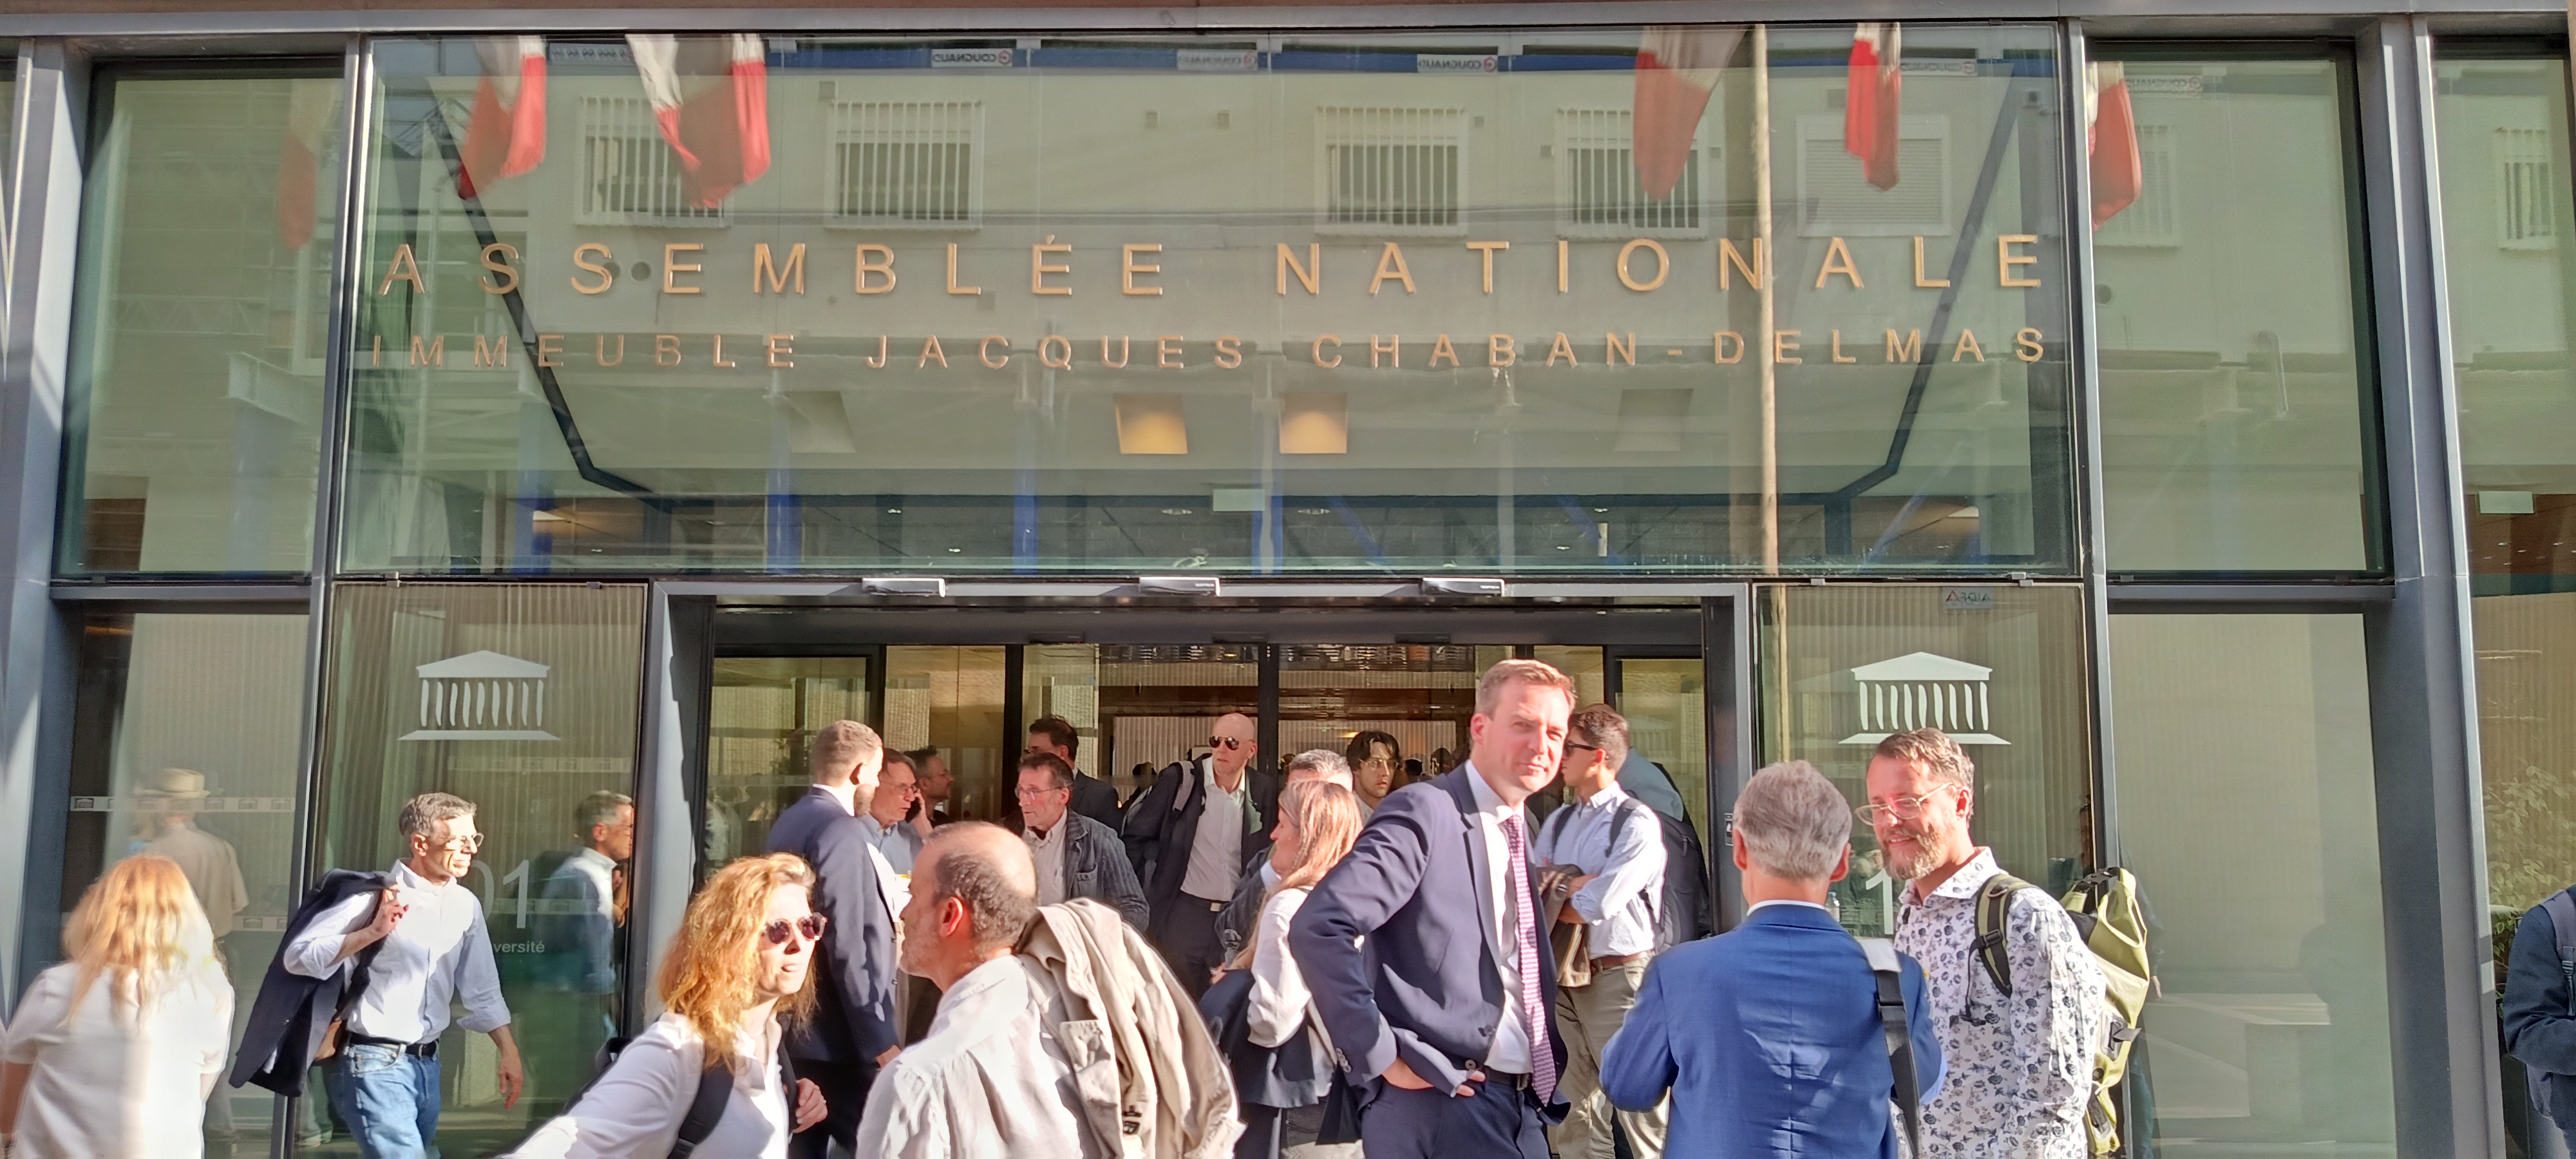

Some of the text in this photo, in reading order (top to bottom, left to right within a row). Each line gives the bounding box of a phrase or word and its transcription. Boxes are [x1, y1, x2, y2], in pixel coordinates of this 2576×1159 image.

[378, 234, 2041, 296] ASSEMBLÉE NATIONALE
[372, 326, 2044, 371] IMMEUBLE JACQUES CHABAN-DELMAS
